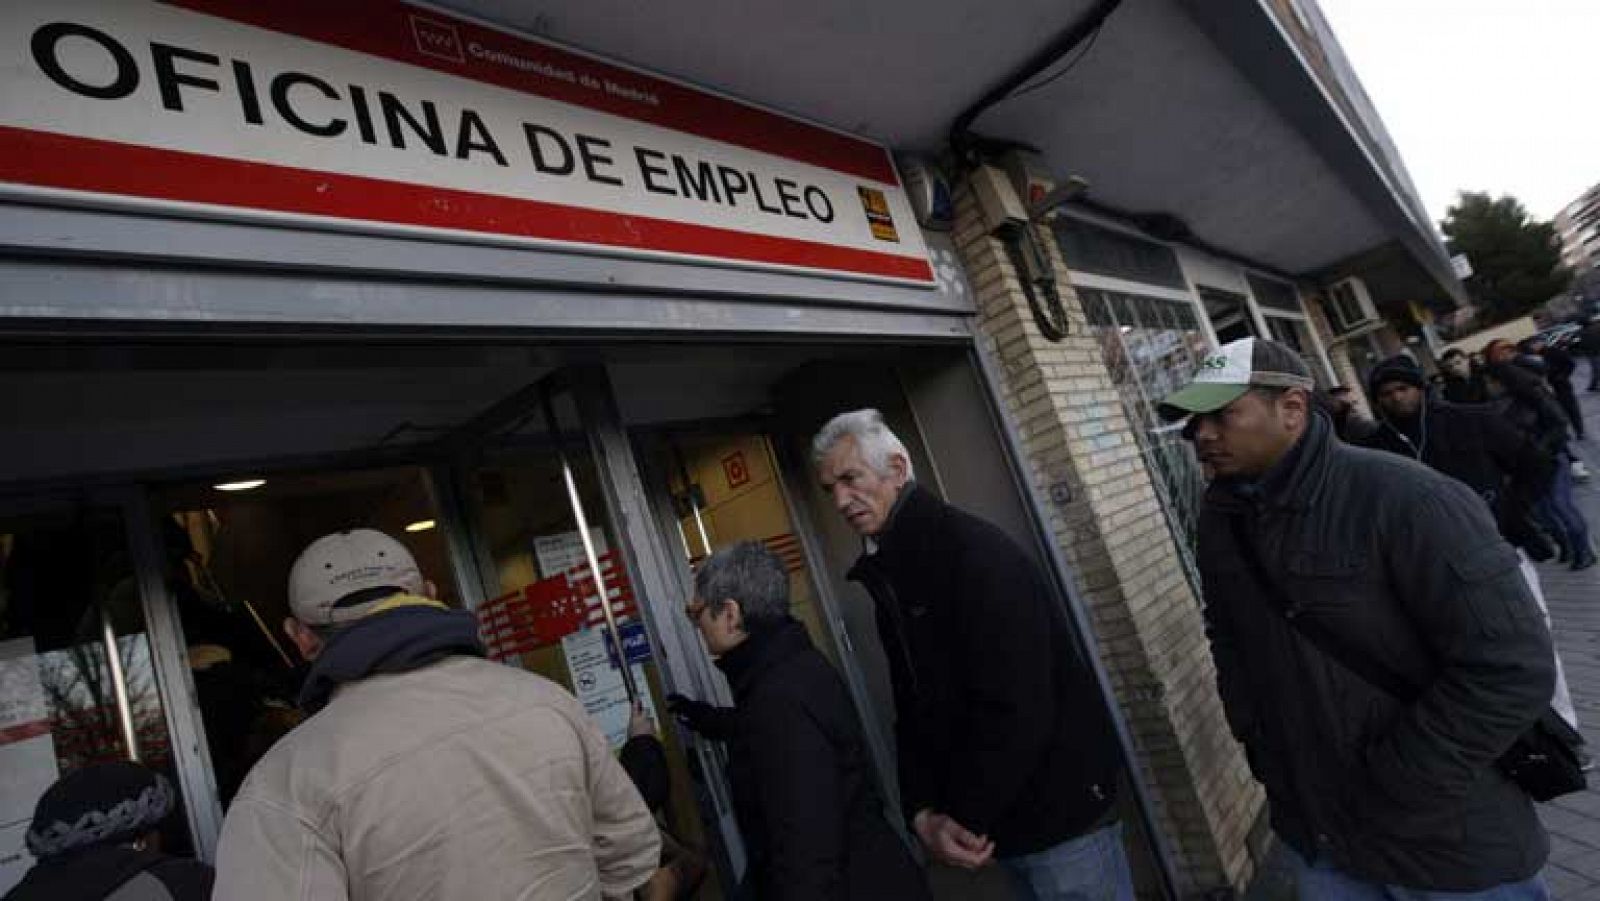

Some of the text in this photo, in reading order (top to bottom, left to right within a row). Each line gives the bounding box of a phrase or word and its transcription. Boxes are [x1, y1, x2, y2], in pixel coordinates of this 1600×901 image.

[31, 22, 835, 224] OFICINA DE EMPLEO
